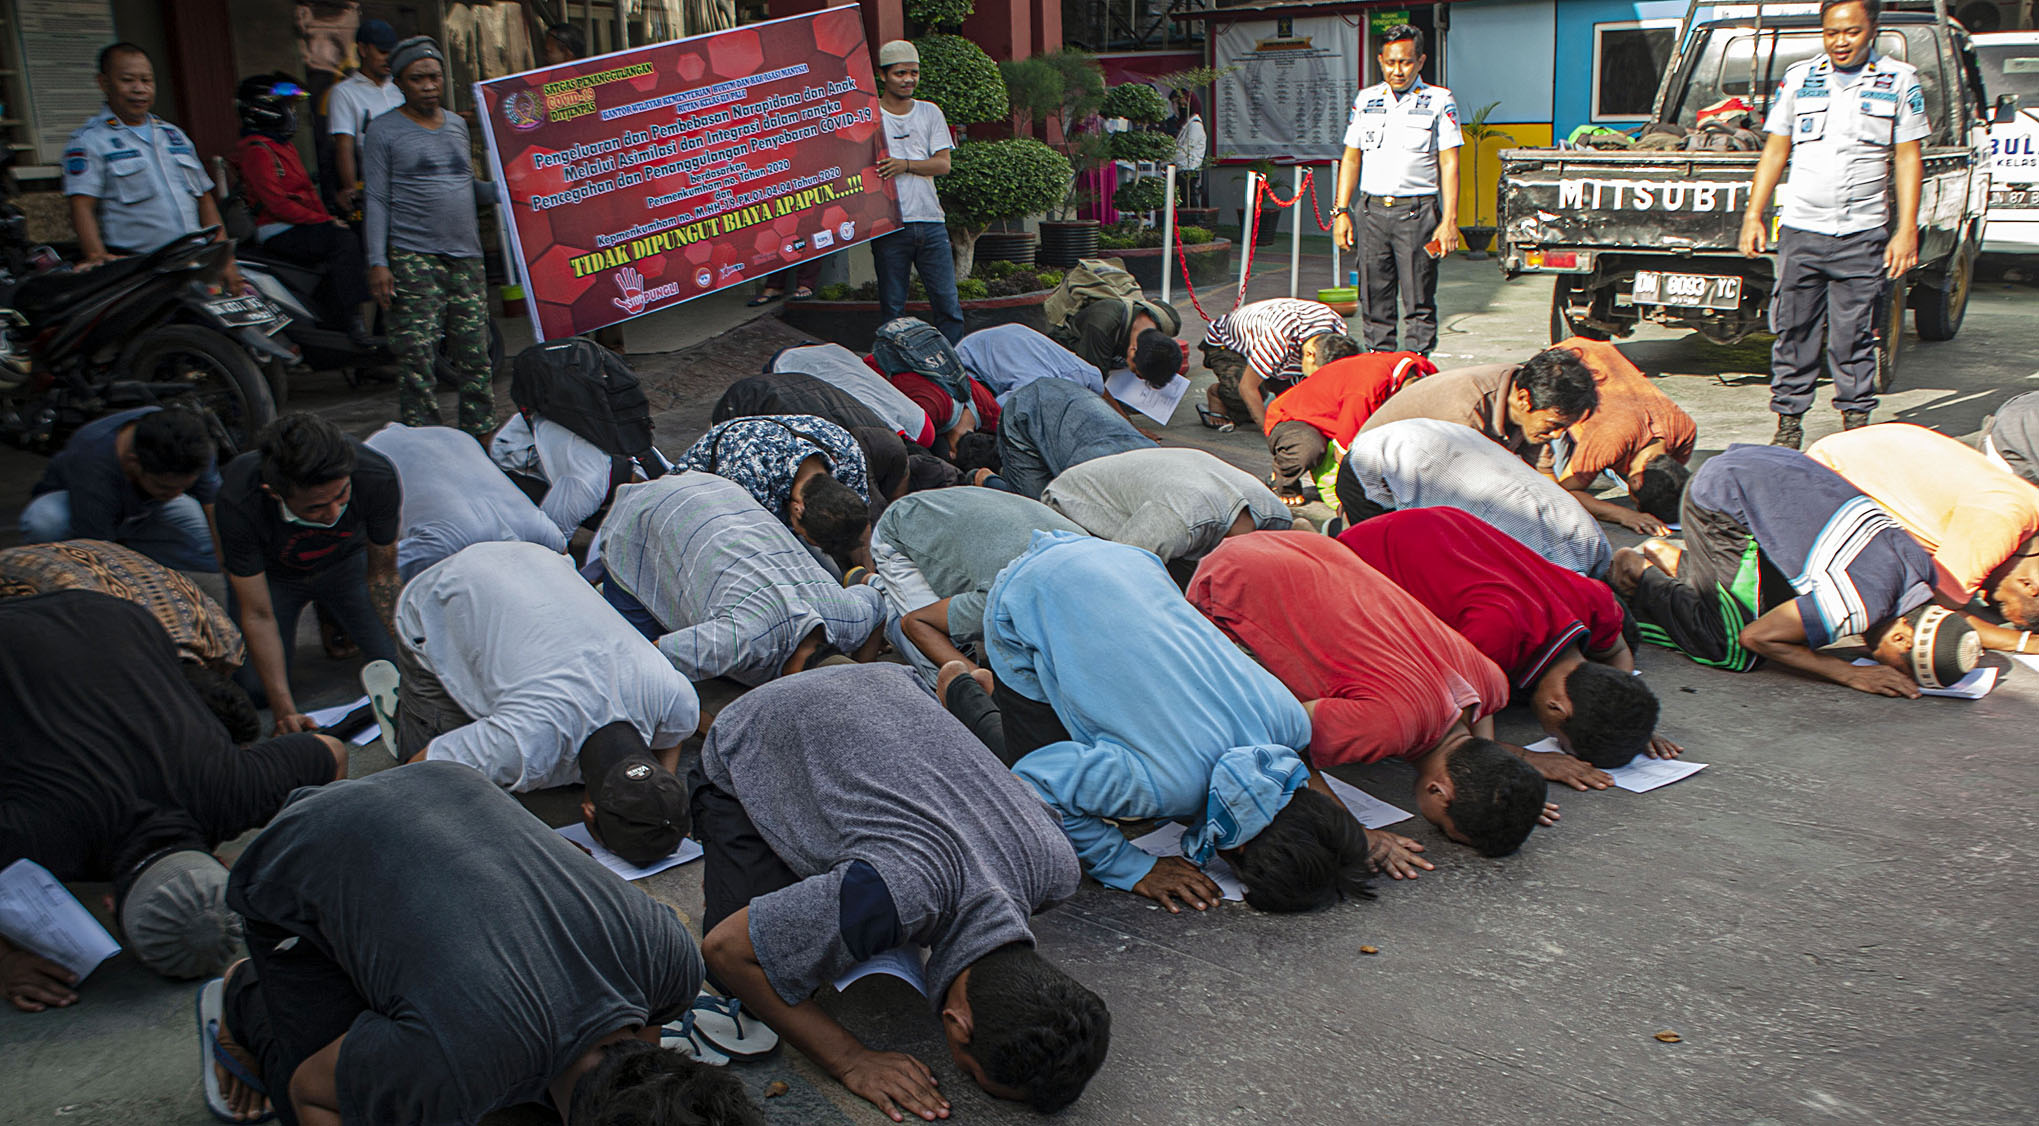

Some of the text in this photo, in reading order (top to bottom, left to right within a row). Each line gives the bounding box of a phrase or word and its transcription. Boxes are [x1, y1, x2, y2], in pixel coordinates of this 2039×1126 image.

[544, 62, 653, 96] SATGAS PENANGGULANGAN
[602, 108, 632, 122] KANTOR
[662, 86, 712, 107] KEMENTERIAN
[712, 82, 736, 94] HUKUM
[736, 78, 750, 88] DAN
[782, 63, 810, 79] MANUSIA
[547, 88, 596, 110] COVID-19
[551, 101, 597, 122] DITJENPAS
[676, 100, 700, 114] RUTAN
[700, 95, 720, 108] KELAS
[730, 88, 748, 103] PALU
[534, 76, 858, 170] Pengeluaran dan Pembebasan Narapidana dan Anak
[563, 100, 842, 182] Melalui Asimilasi dan Integrasi dalam rangka
[531, 108, 872, 212] Pencegahan dan Penanggulangan Penyebaran COVID-19
[690, 161, 747, 186] berdasarkan
[648, 159, 790, 208] Permenkumham no. Tahun 2020
[714, 188, 733, 202] dan
[1559, 179, 1753, 212] MITSUBI
[596, 218, 677, 248] Kepmenkumham
[678, 212, 694, 224] no.
[793, 173, 818, 190] Tahun
[820, 166, 842, 182] 2020
[570, 244, 632, 278] TIDAK
[632, 217, 720, 261] DIPUNGUT
[721, 201, 774, 234] BIAYA
[626, 282, 680, 309] STOP PUNGLI
[1667, 276, 1706, 296] 8093
[1717, 278, 1737, 299] YC
